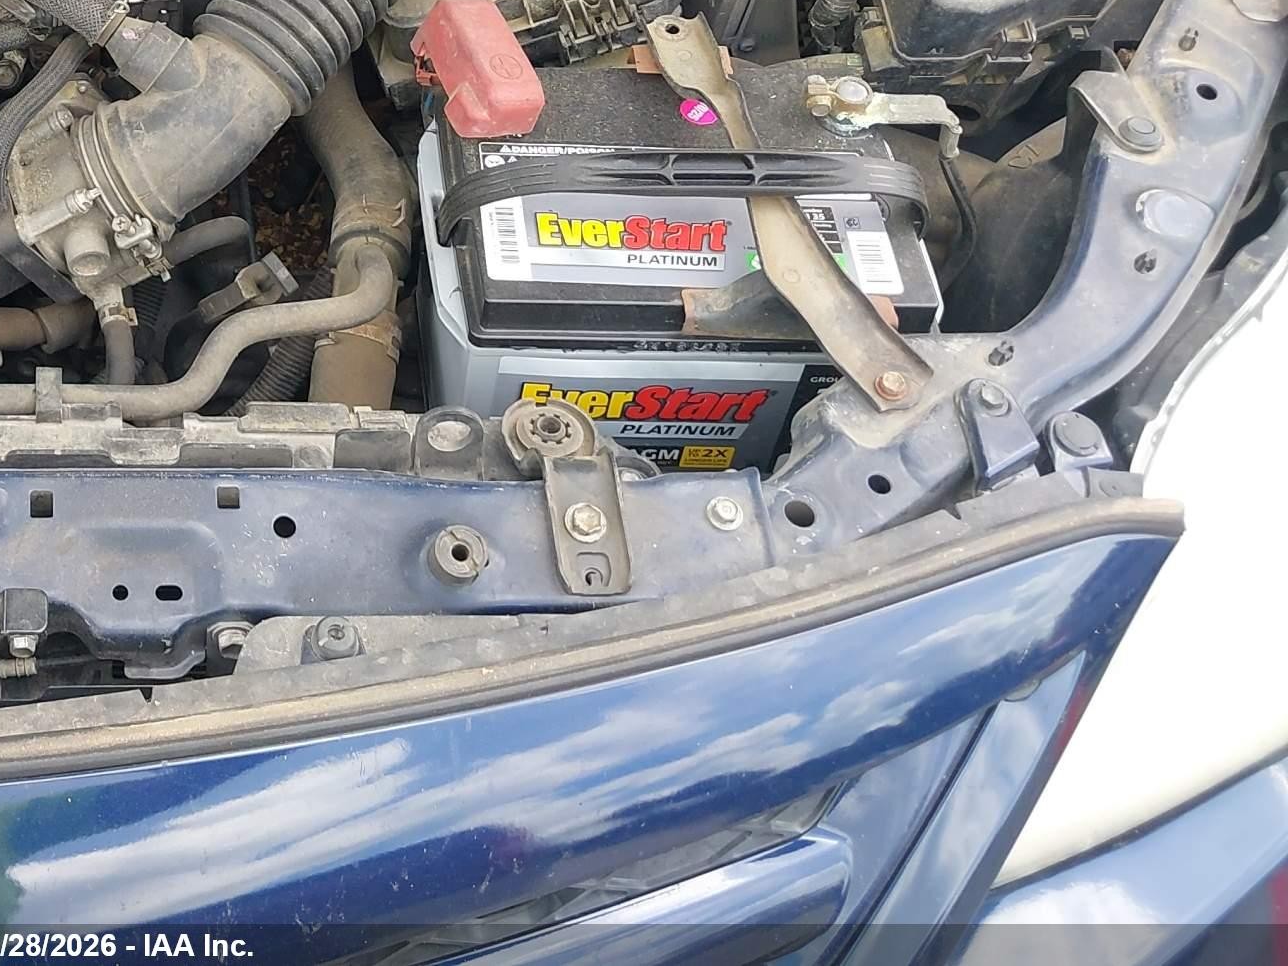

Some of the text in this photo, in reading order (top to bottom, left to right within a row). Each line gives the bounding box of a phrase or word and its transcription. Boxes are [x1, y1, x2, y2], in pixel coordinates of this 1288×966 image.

[535, 211, 727, 252] EverStart
[627, 253, 718, 267] PLATINUM
[620, 424, 737, 436] PLATINUM
[702, 448, 729, 458] 2X
